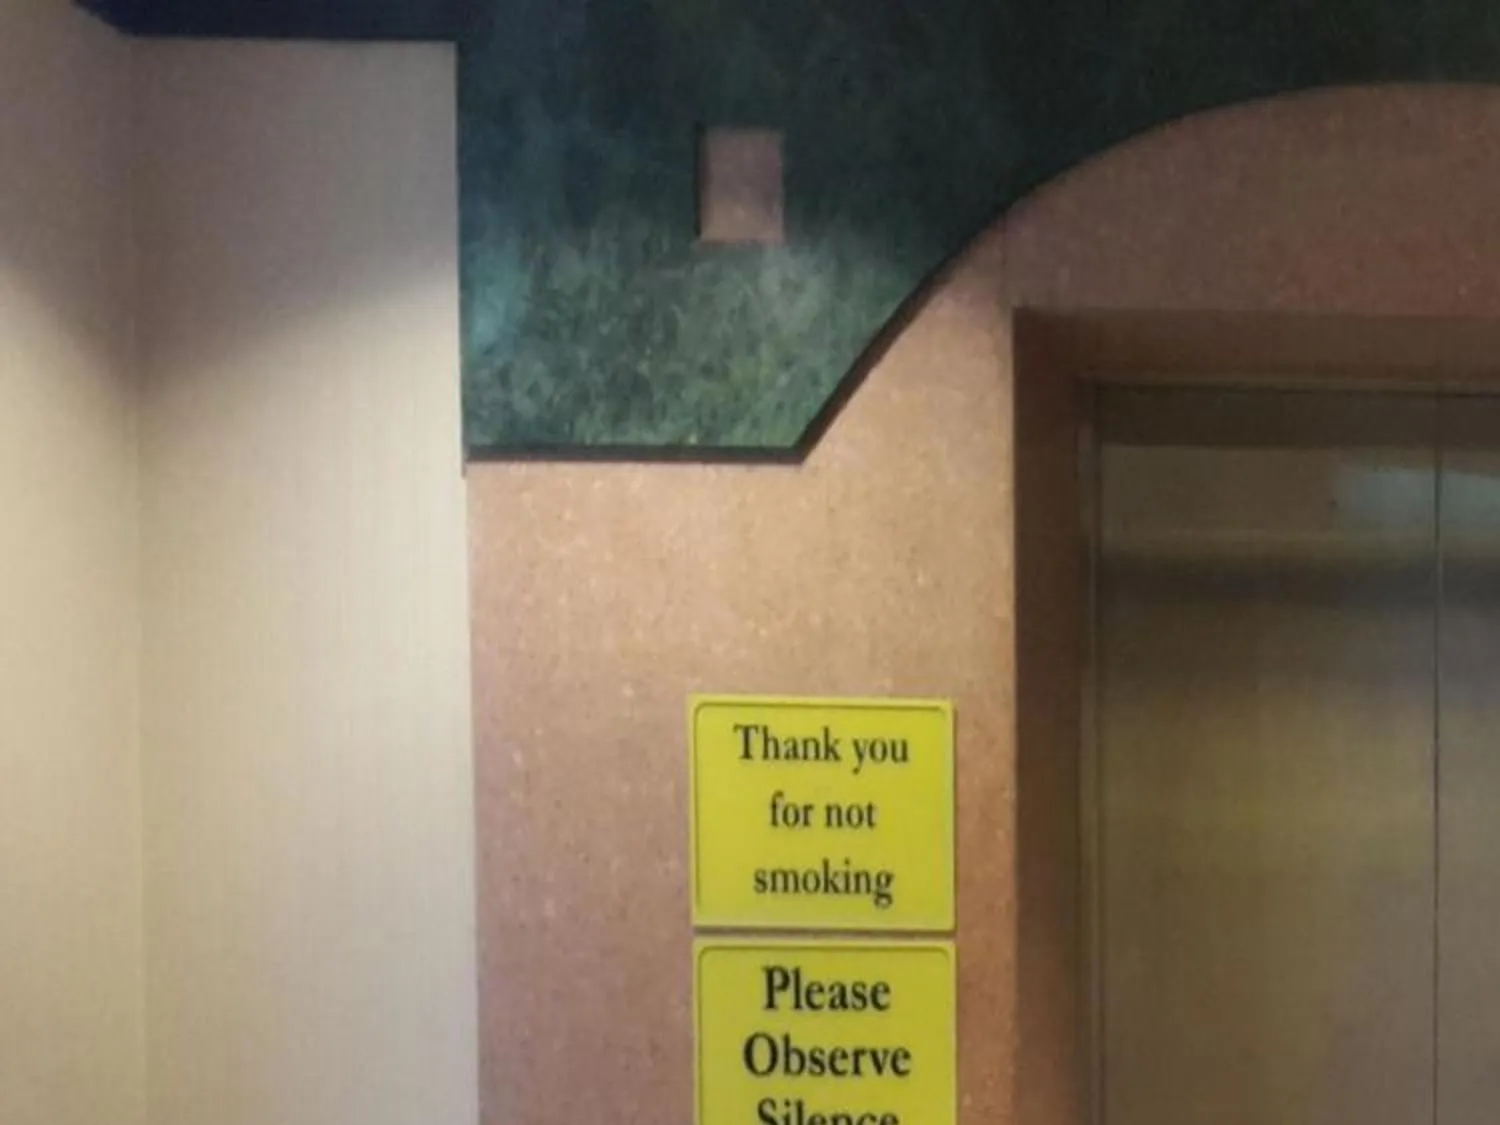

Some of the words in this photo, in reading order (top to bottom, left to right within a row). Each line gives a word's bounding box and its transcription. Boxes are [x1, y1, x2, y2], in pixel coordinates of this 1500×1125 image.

[734, 723, 841, 763] Thank
[851, 736, 909, 775] you
[769, 791, 815, 829] for
[825, 801, 876, 829] not
[753, 858, 895, 908] smoking
[761, 965, 891, 1012] Please
[743, 1032, 912, 1077] Observe
